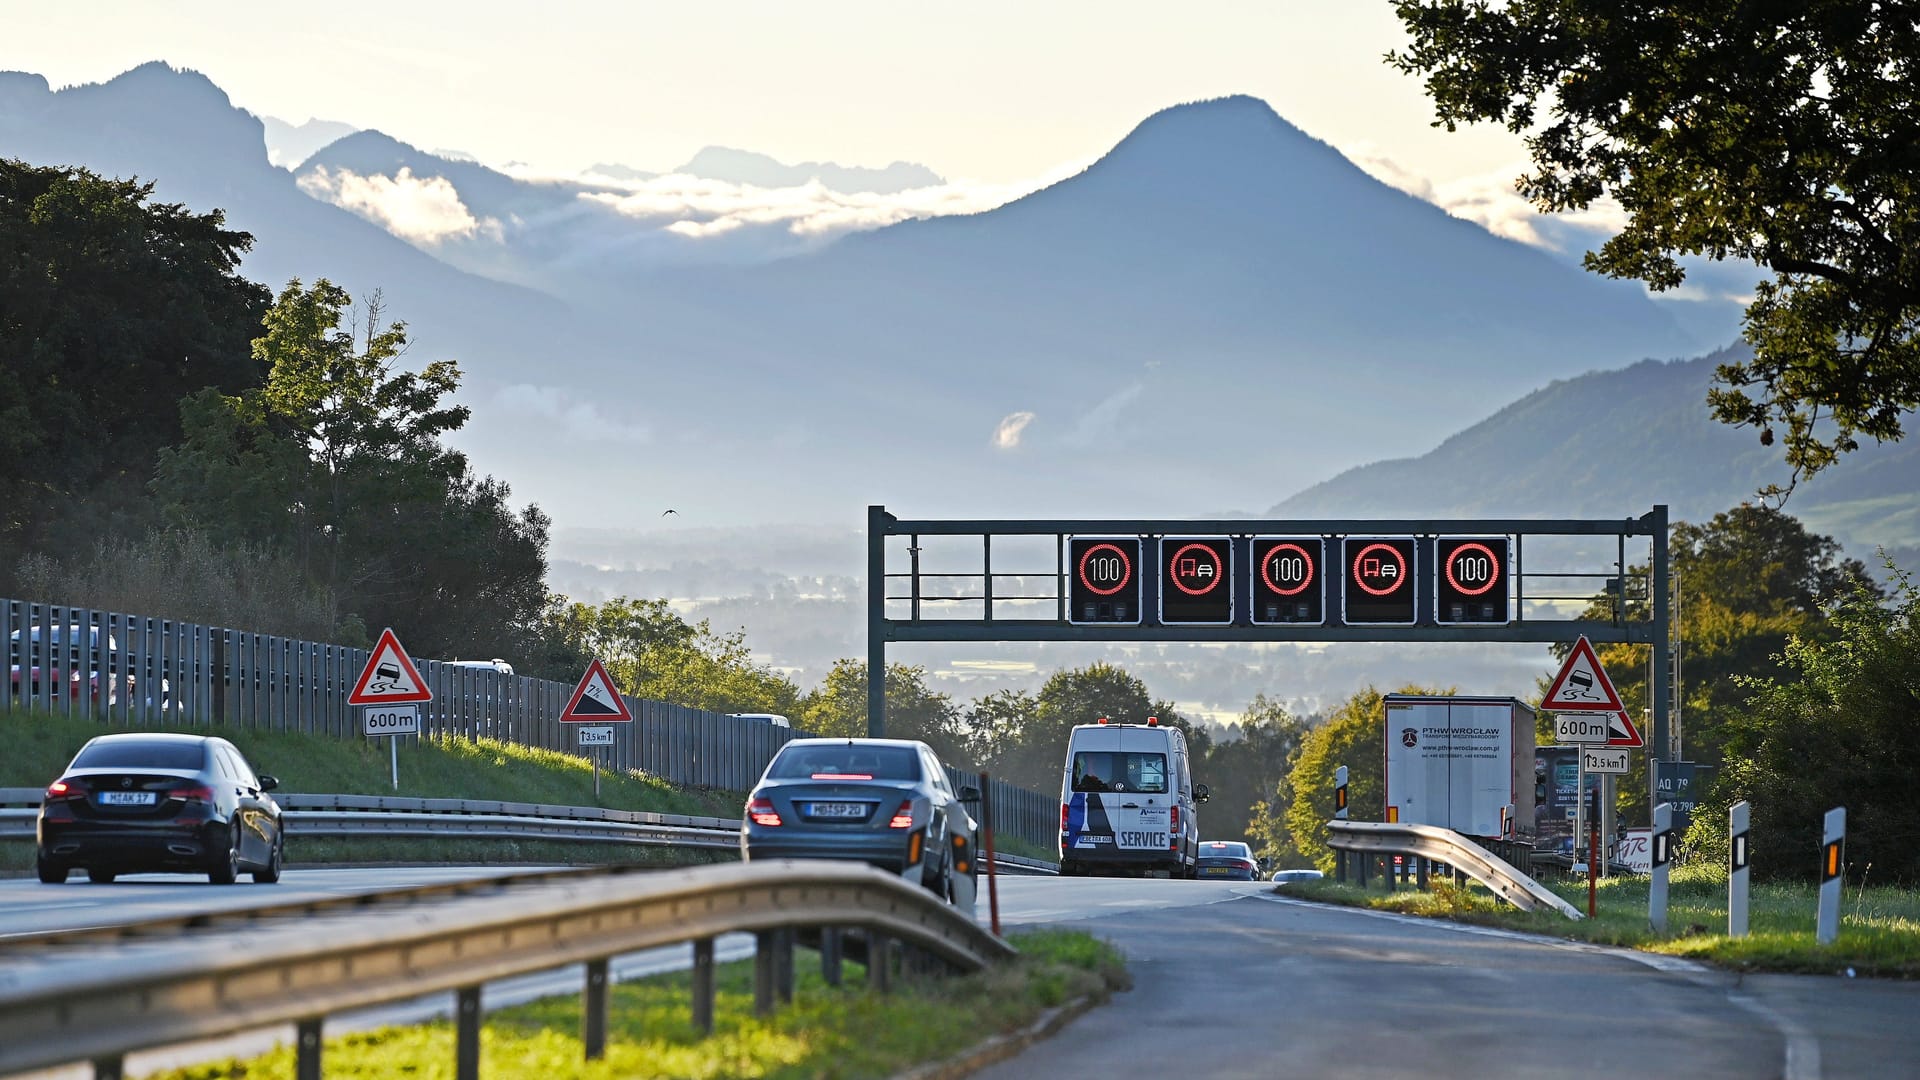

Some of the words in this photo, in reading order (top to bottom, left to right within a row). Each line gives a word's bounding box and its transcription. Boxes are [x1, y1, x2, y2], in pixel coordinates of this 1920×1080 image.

[1089, 558, 1120, 581] 100
[1272, 558, 1302, 581] 100
[1456, 558, 1487, 581] 100
[1121, 831, 1166, 847] SERVICE
